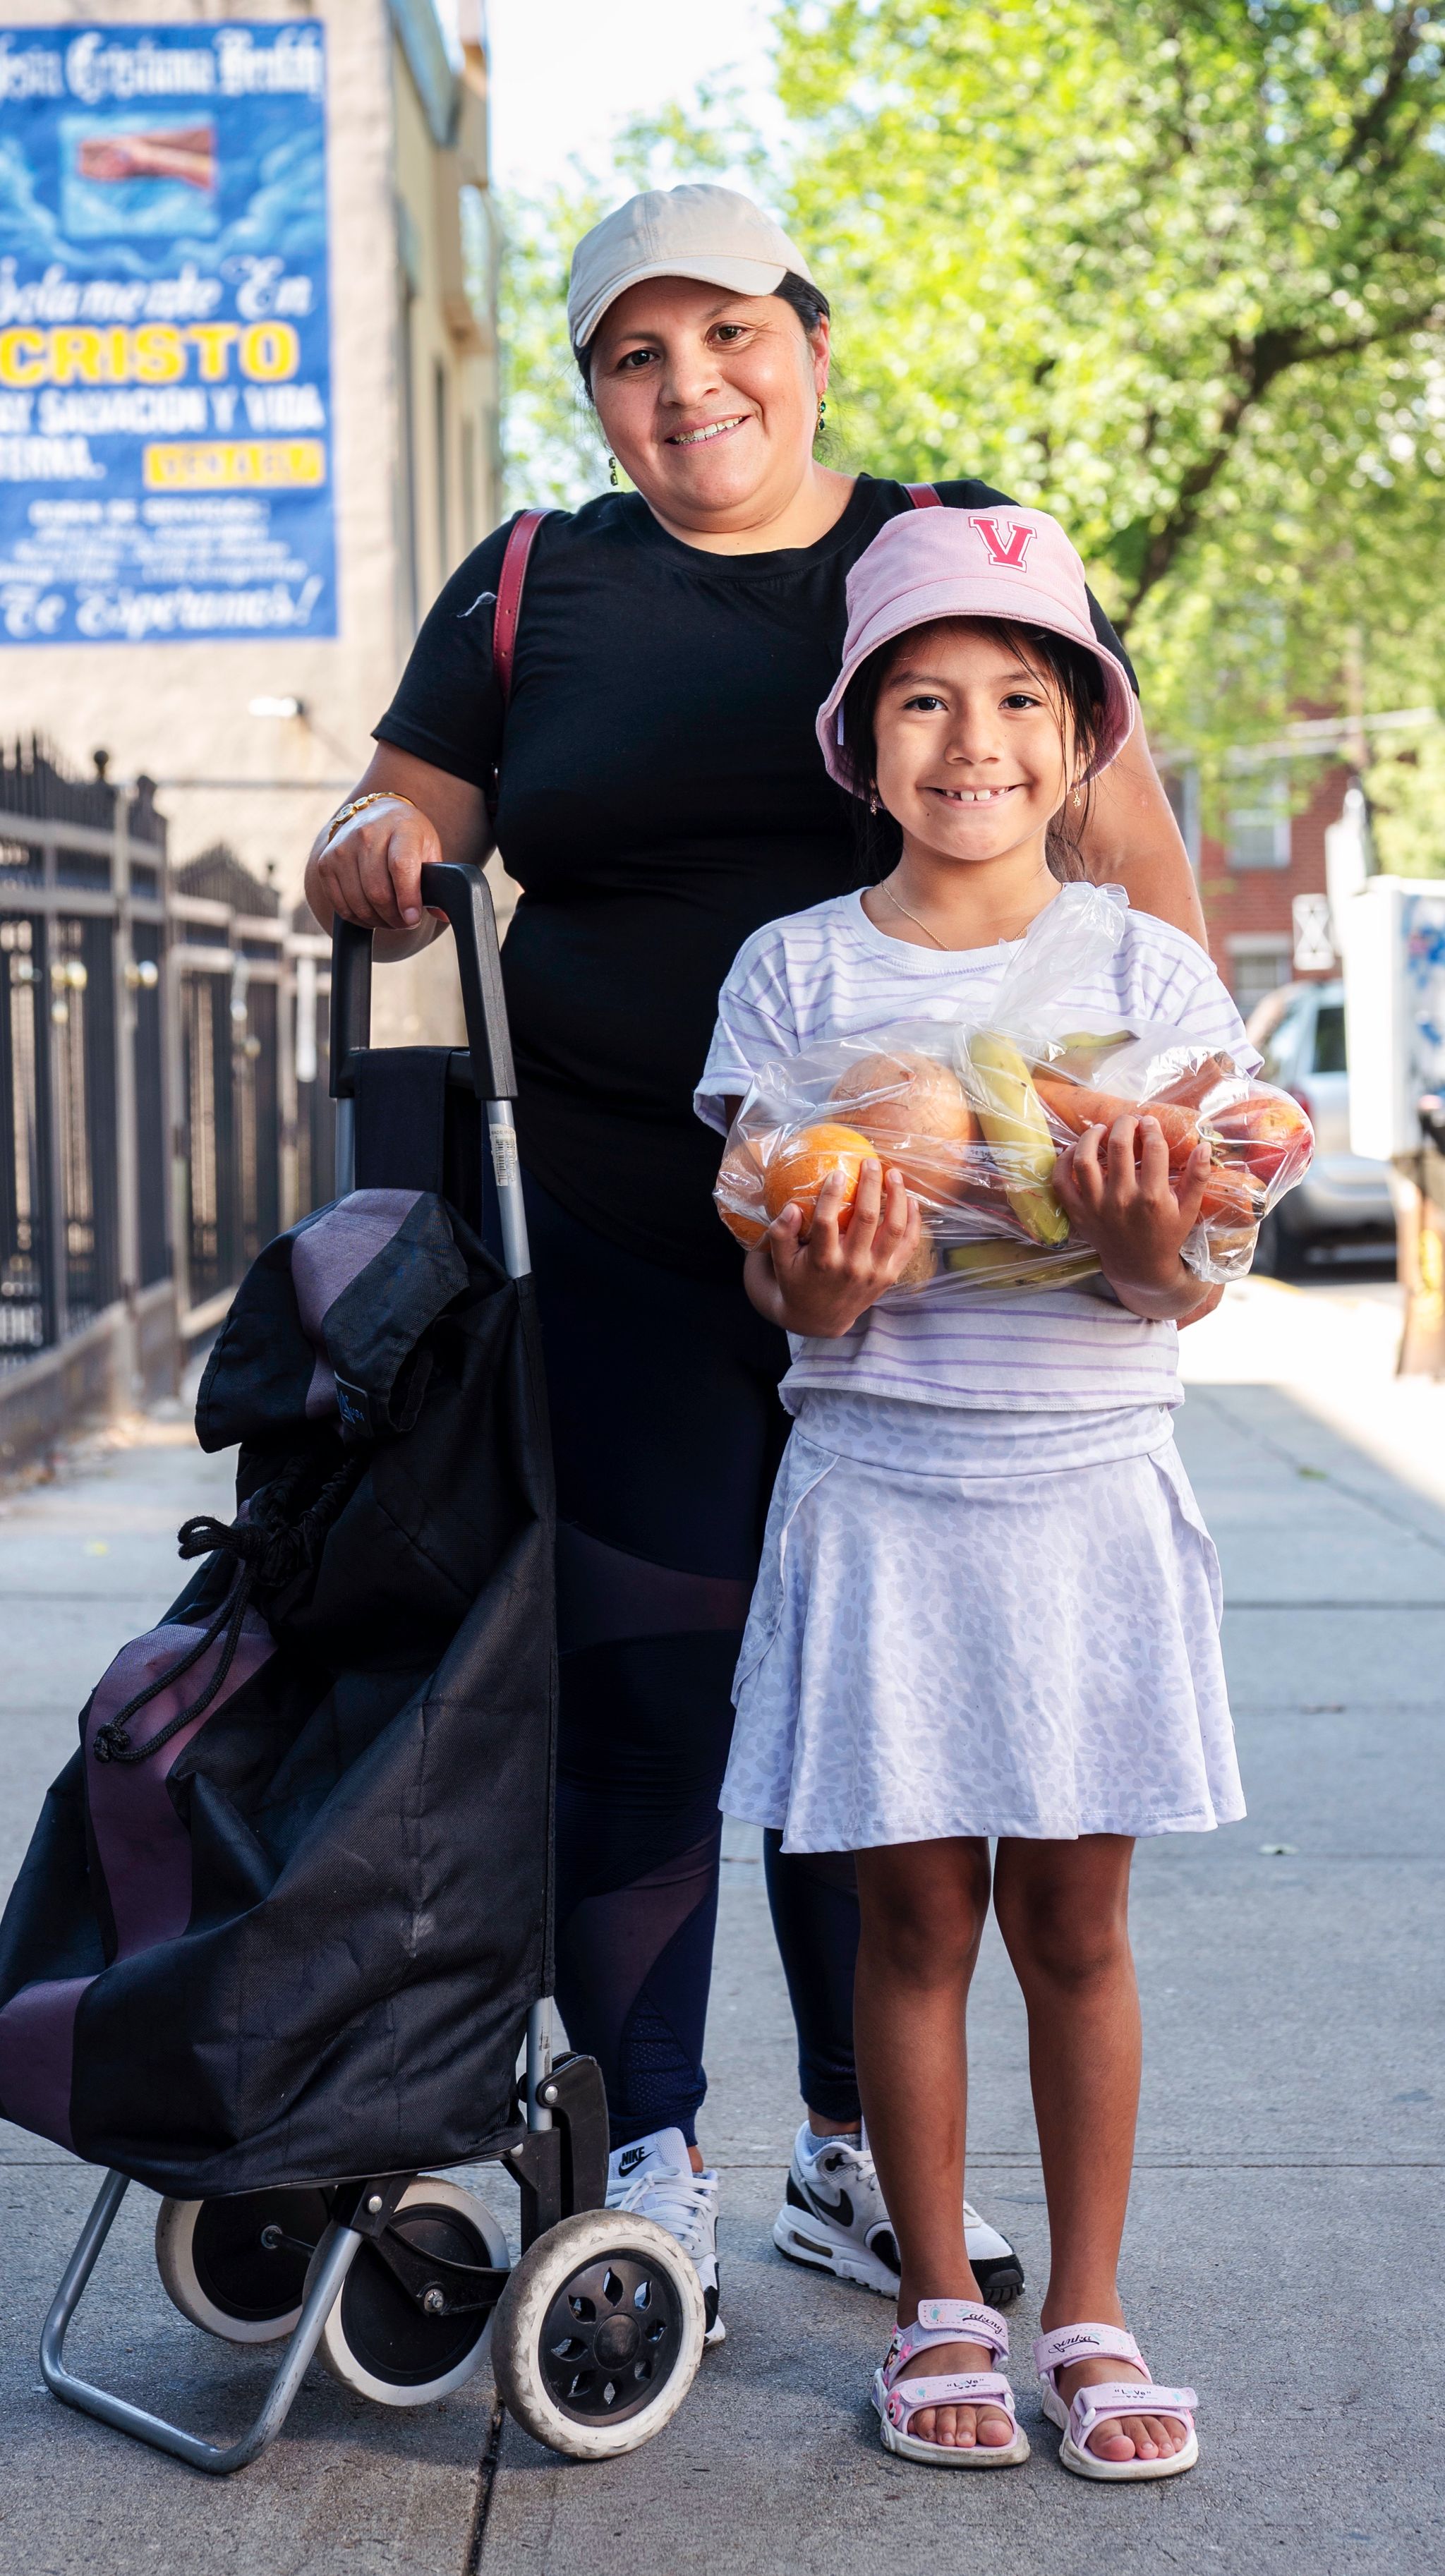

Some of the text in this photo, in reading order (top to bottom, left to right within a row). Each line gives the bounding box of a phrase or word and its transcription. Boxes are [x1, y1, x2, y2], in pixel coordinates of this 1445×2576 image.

[0, 323, 299, 386] CRISTO
[209, 385, 238, 432] Y
[243, 384, 325, 431] VIDA
[968, 516, 1037, 573] V
[622, 2146, 645, 2166] NIKE
